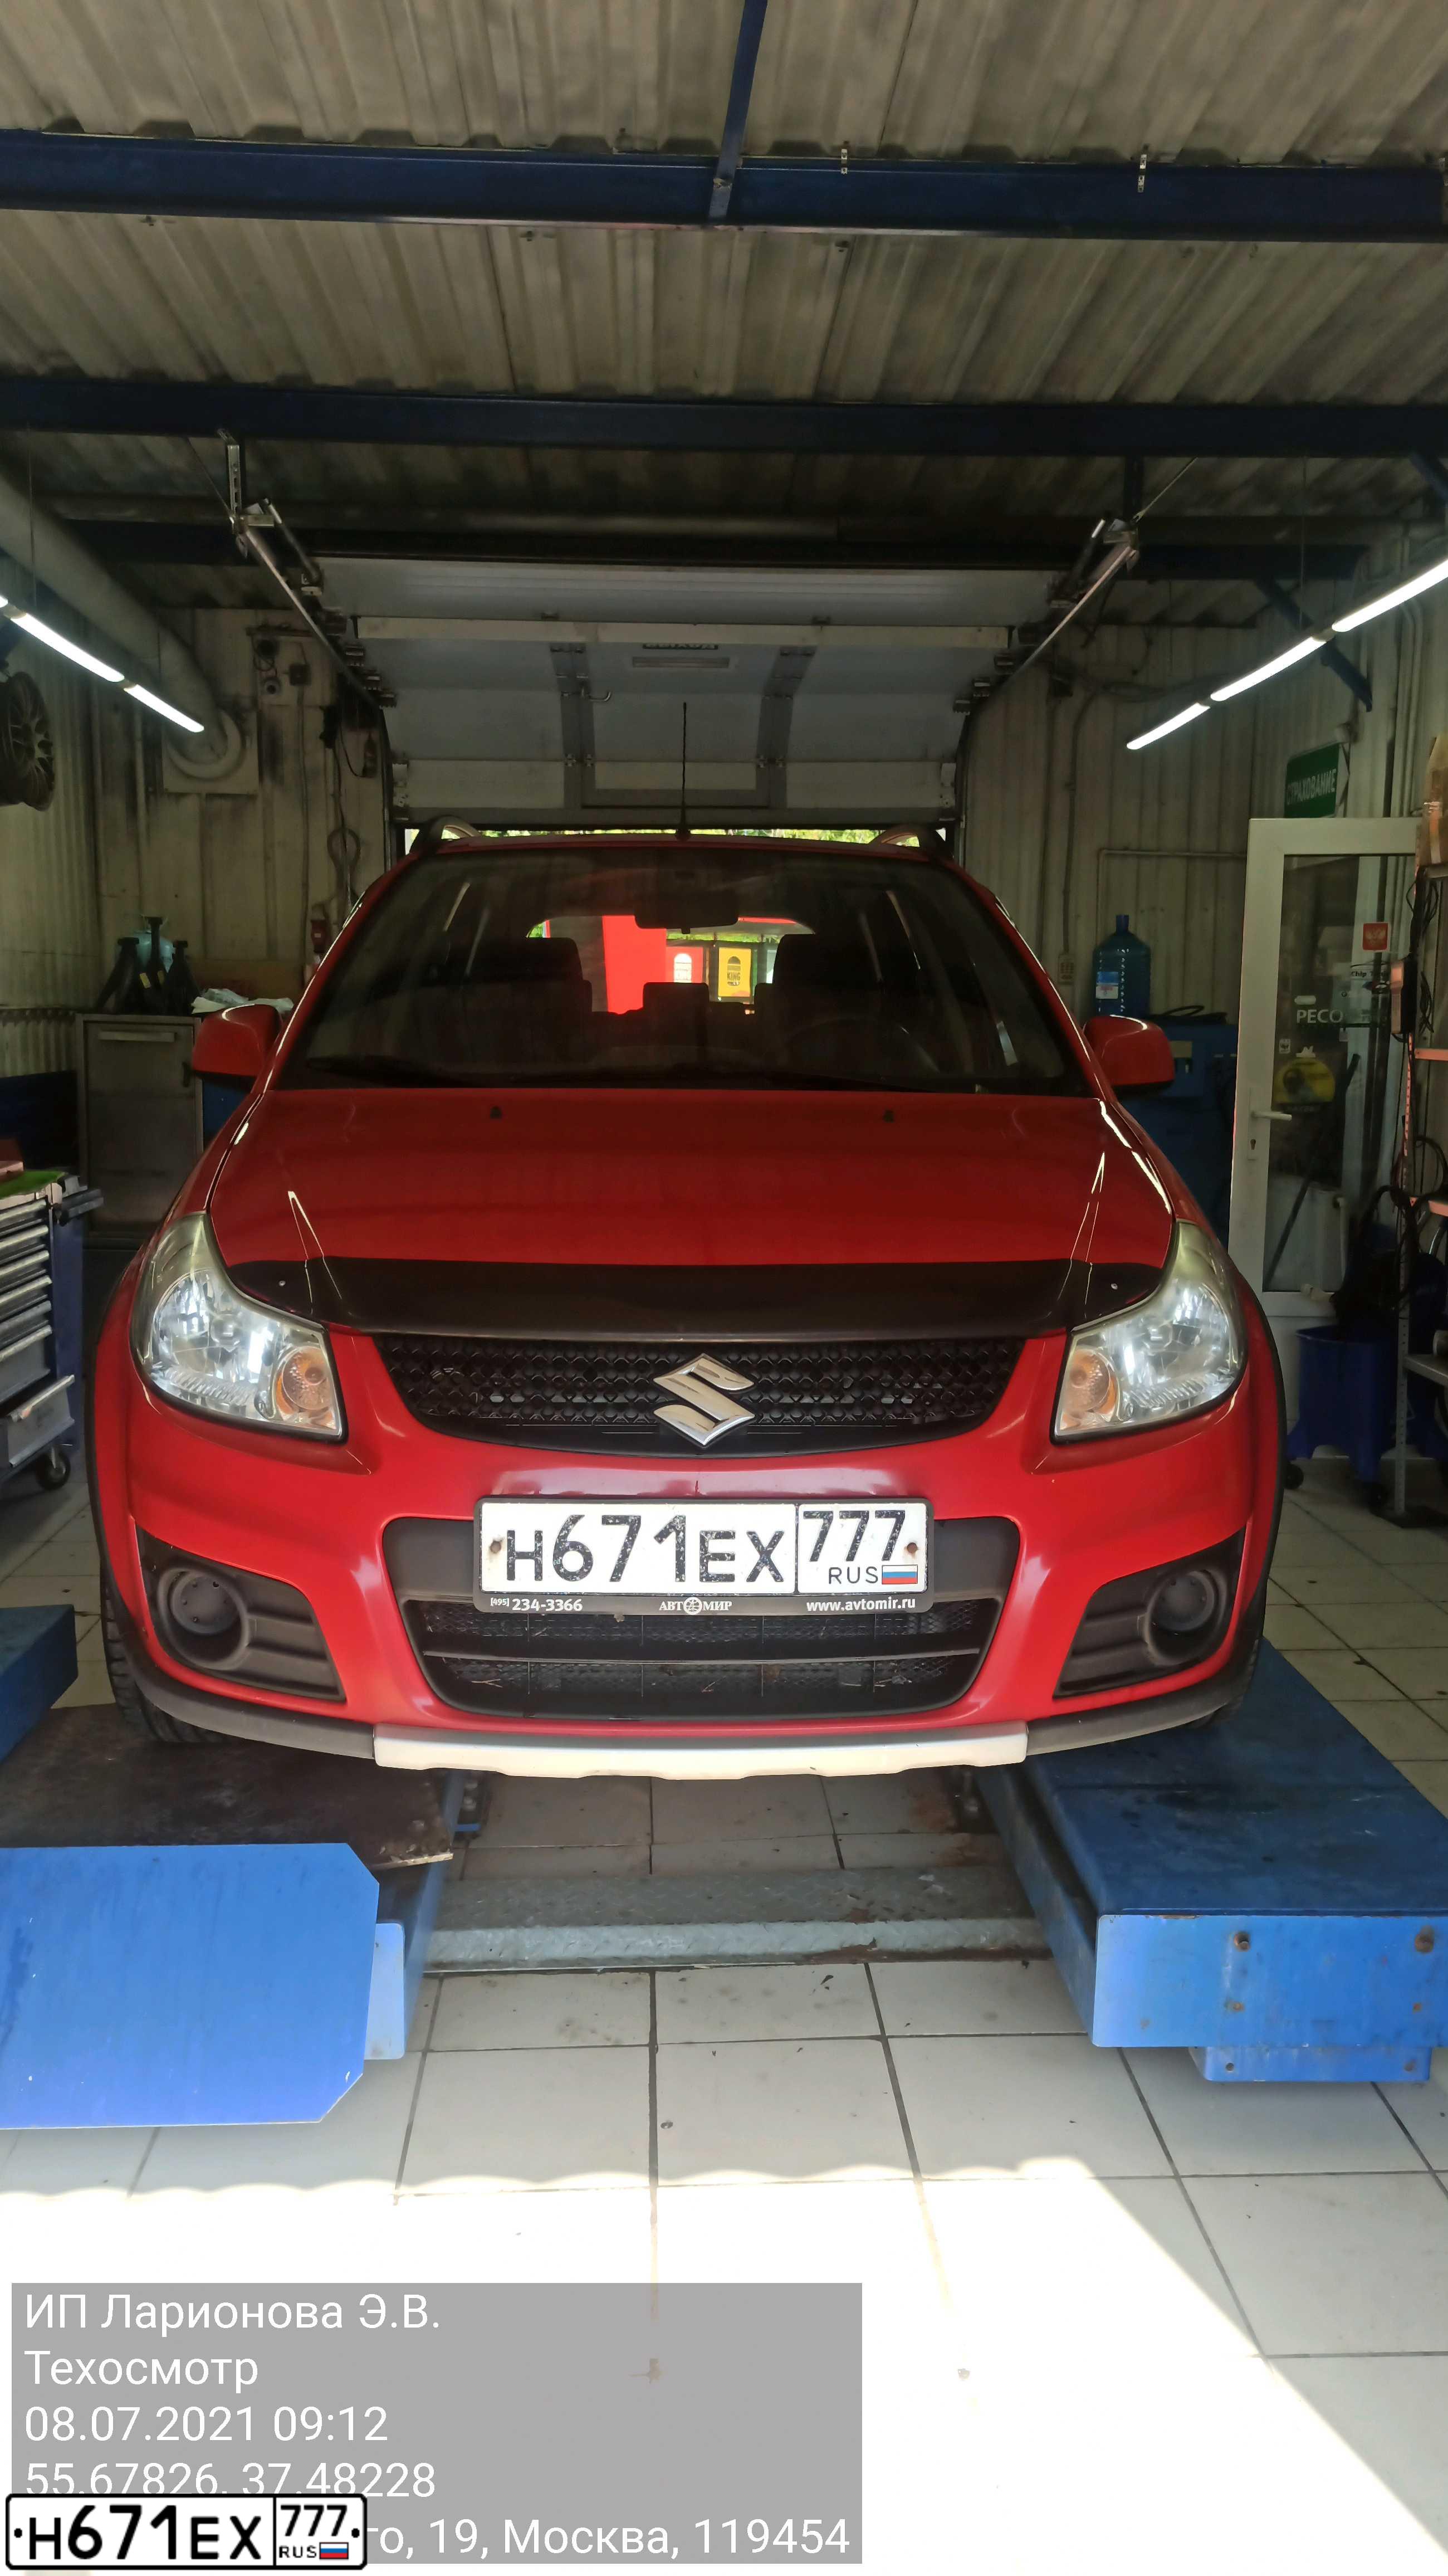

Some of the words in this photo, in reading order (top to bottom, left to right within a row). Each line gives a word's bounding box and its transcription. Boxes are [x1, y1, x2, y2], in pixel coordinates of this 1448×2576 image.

[803, 1510, 907, 1562] 777
[828, 1565, 879, 1584] RUS
[512, 1598, 583, 1612] 234-3366
[806, 1597, 916, 1612] www.avtomir.ru
